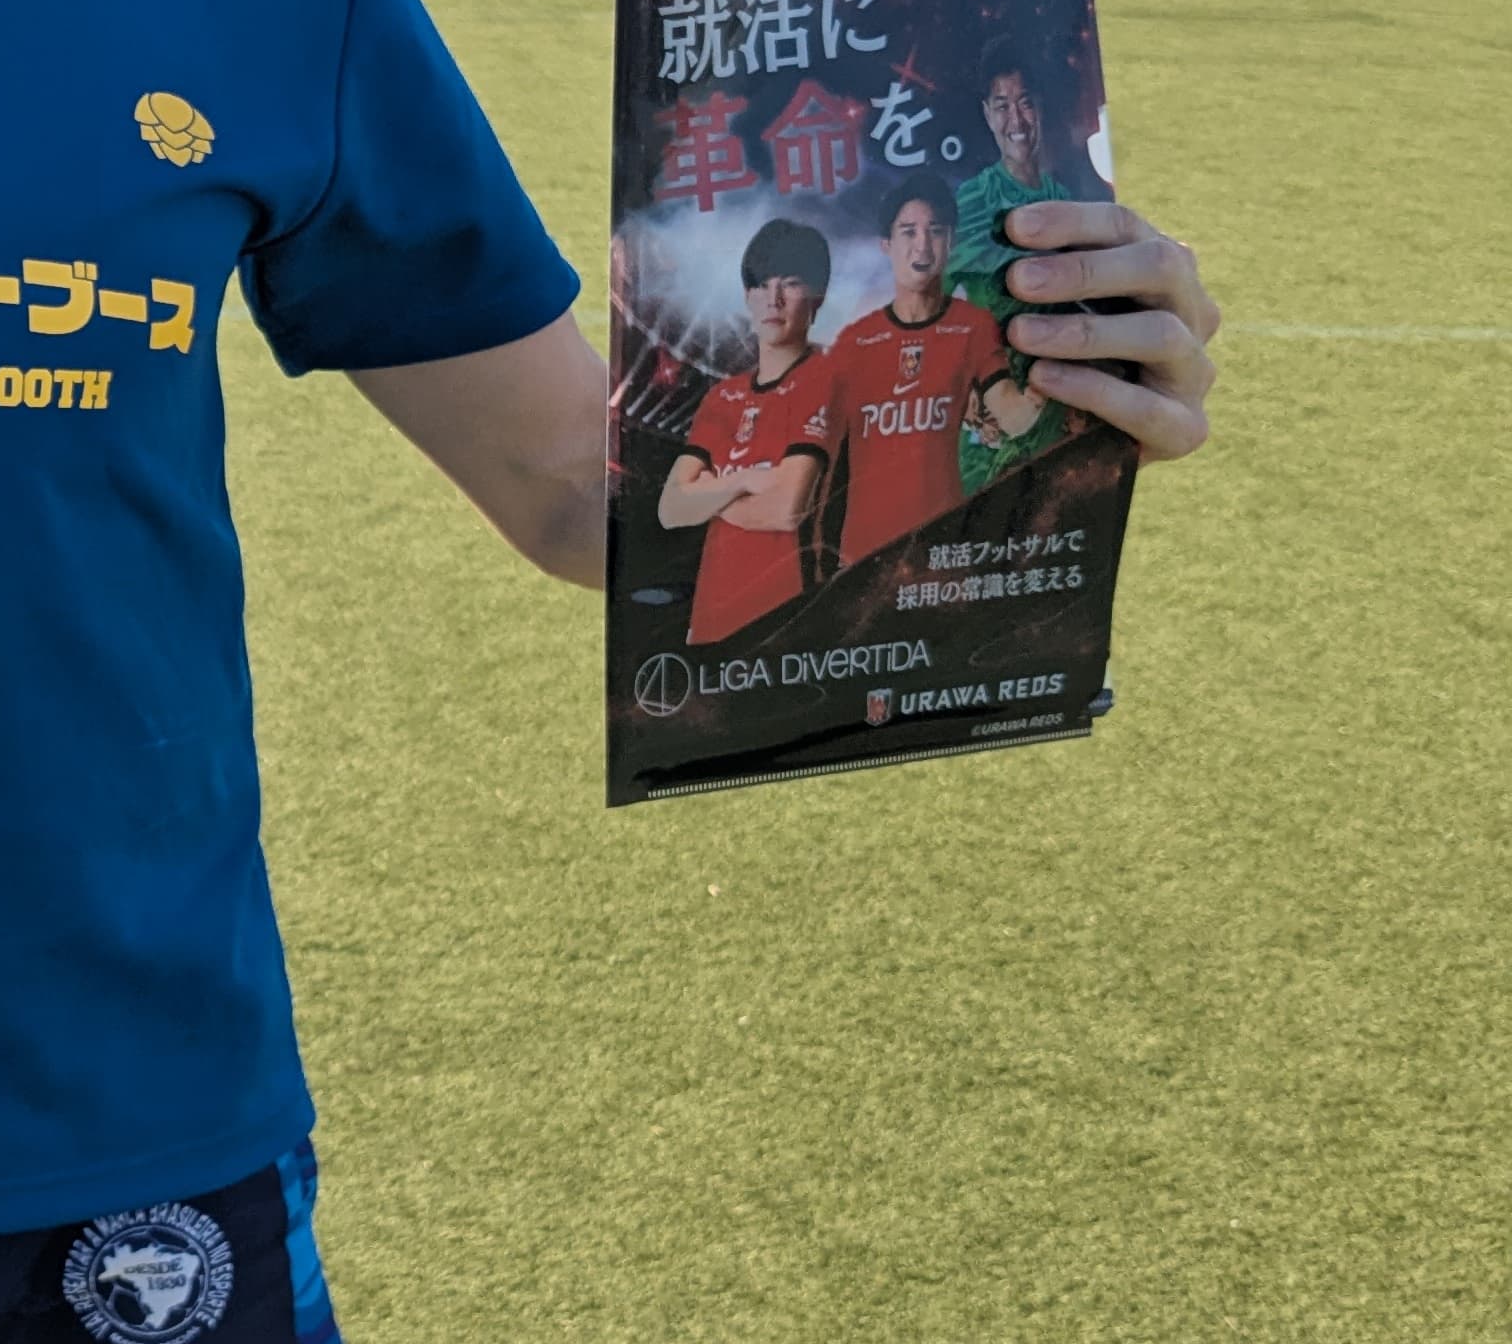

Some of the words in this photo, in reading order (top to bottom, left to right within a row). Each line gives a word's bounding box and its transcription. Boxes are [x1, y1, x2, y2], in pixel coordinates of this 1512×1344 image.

[652, 78, 966, 213] 革命を。
[861, 396, 952, 439] POLUS
[928, 529, 1085, 570] 就活フットサルで
[895, 564, 1084, 612] 採用の常識を変える
[900, 683, 989, 715] URAWA
[998, 672, 1067, 702] REDS
[1028, 712, 1065, 729] REDS
